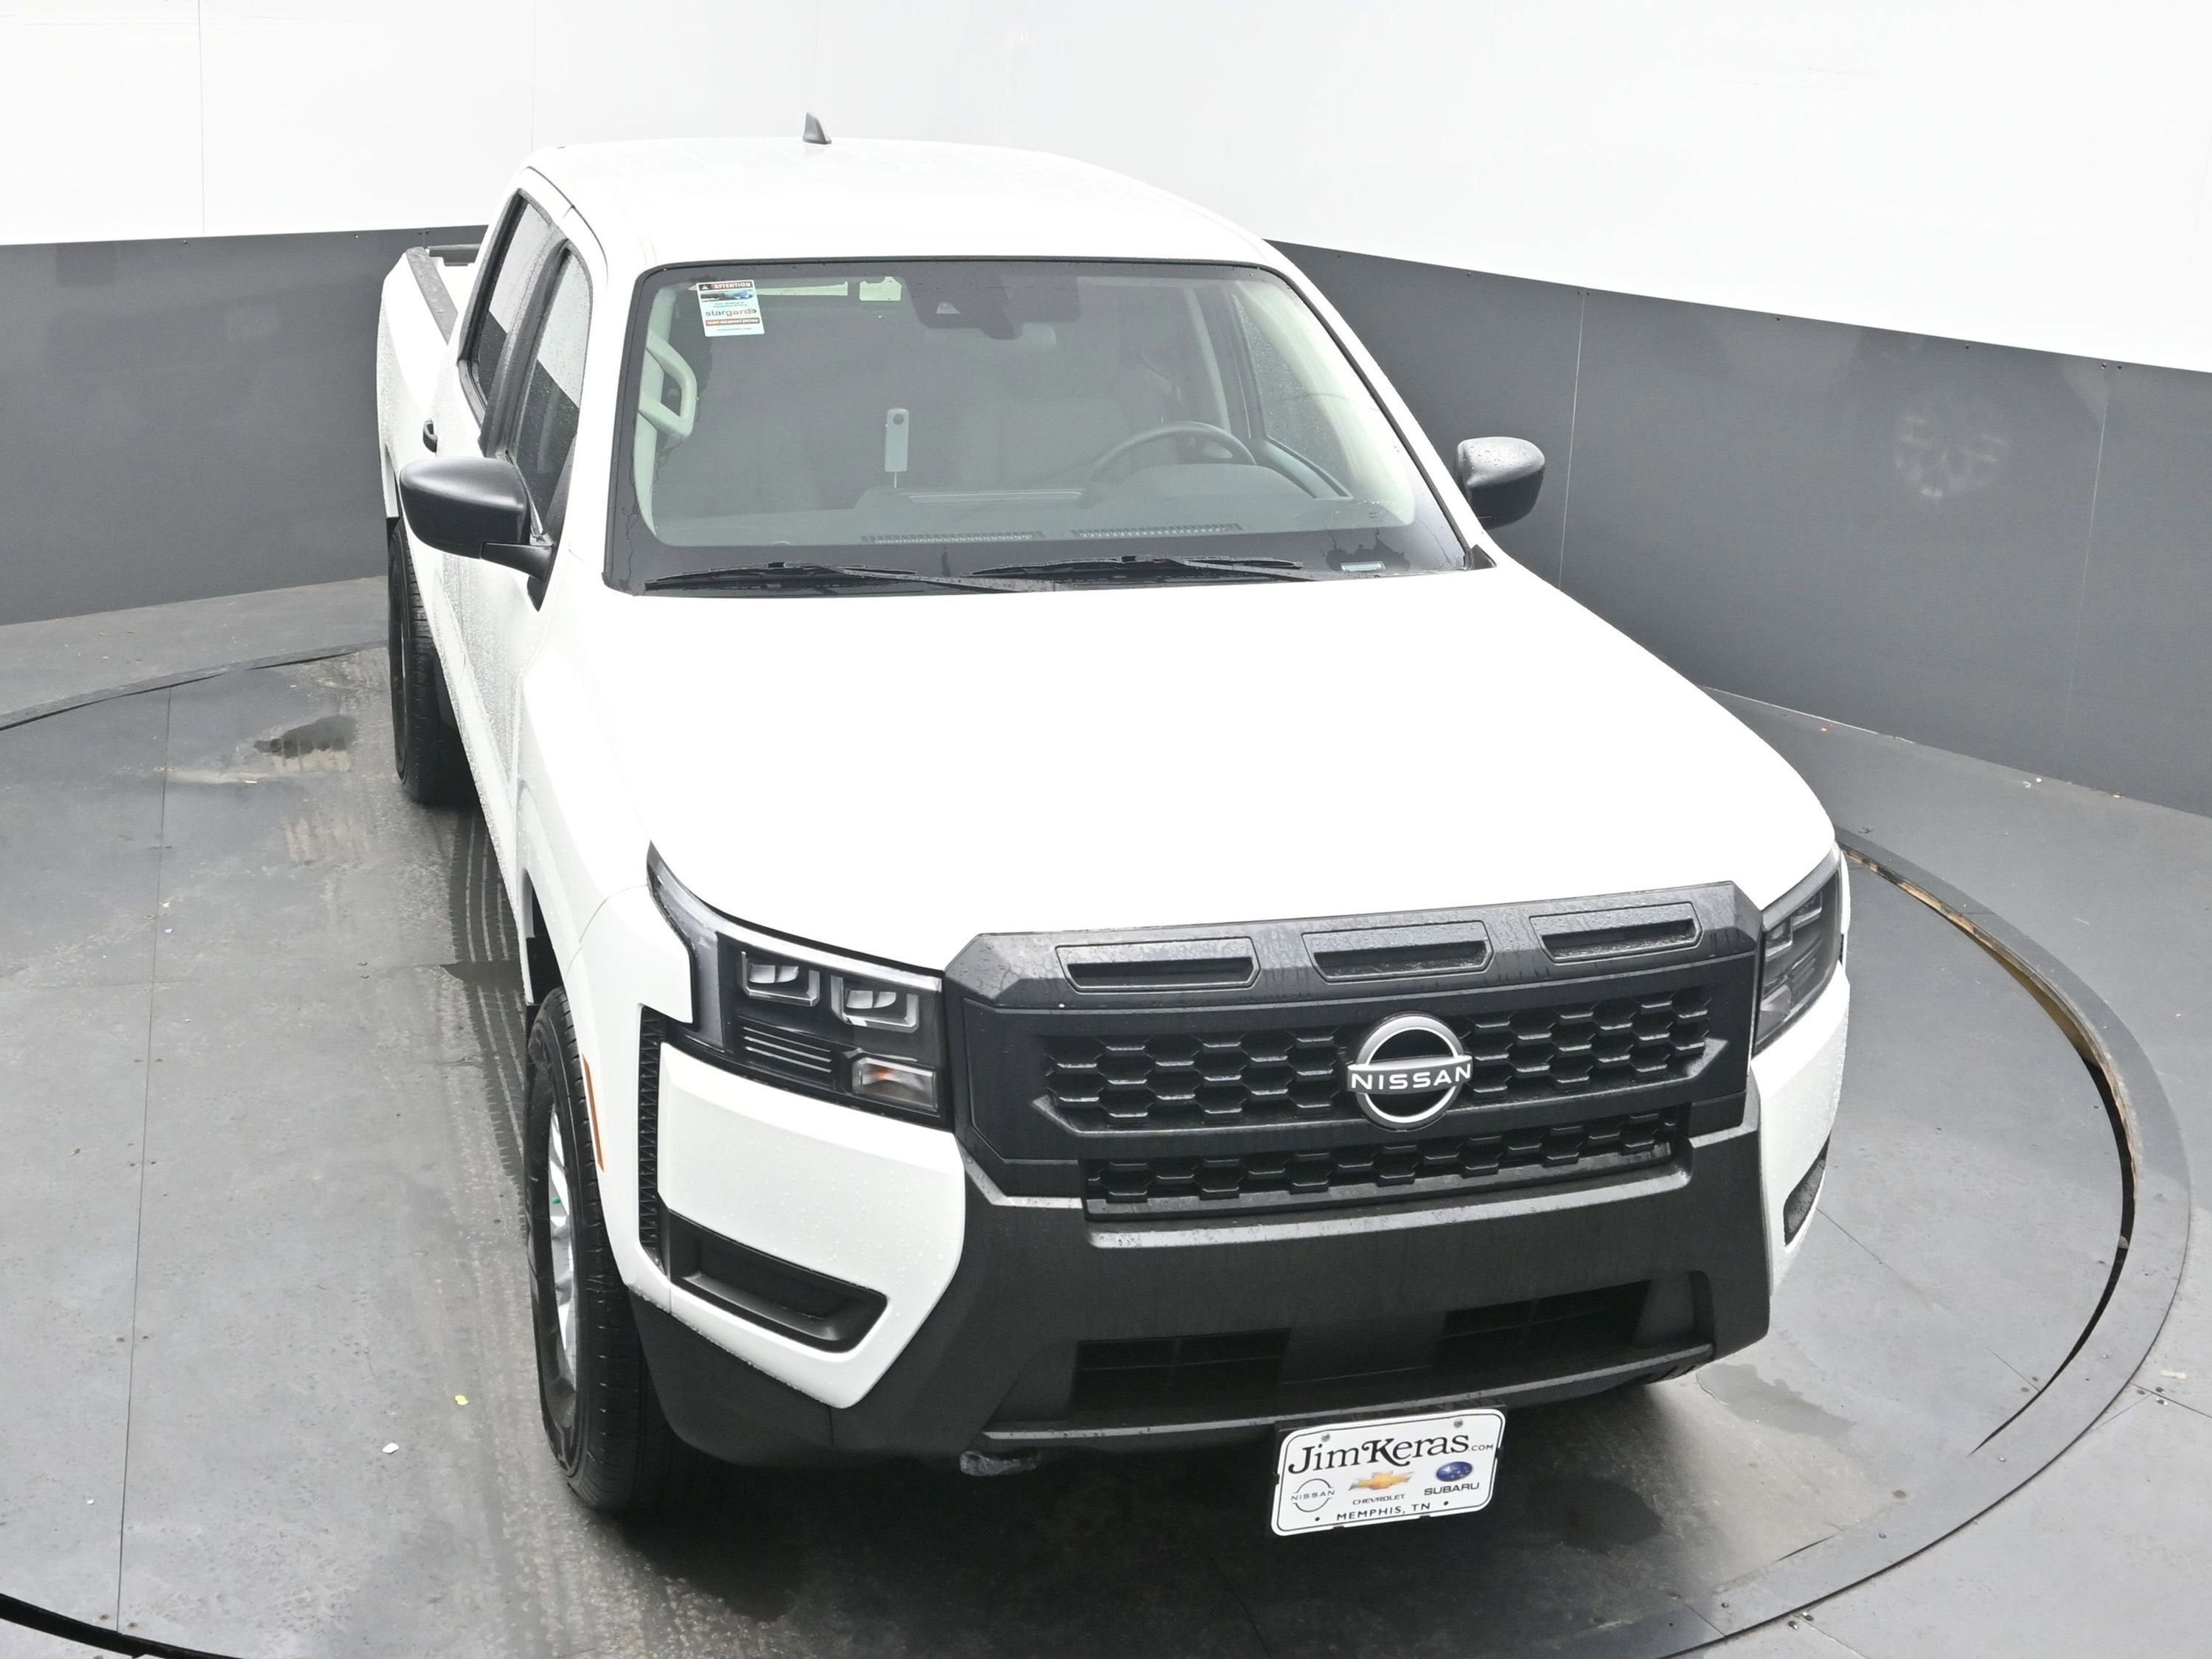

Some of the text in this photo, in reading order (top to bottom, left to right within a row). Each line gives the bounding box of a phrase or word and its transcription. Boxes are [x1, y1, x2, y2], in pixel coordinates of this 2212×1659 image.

[1351, 1063, 1472, 1091] NISSAN
[1291, 1489, 1335, 1501] NISSAN
[1424, 1483, 1479, 1495] SUBARU
[1352, 1494, 1405, 1505] CHEVROLET
[1337, 1503, 1430, 1520] MEMPHIS, TN
